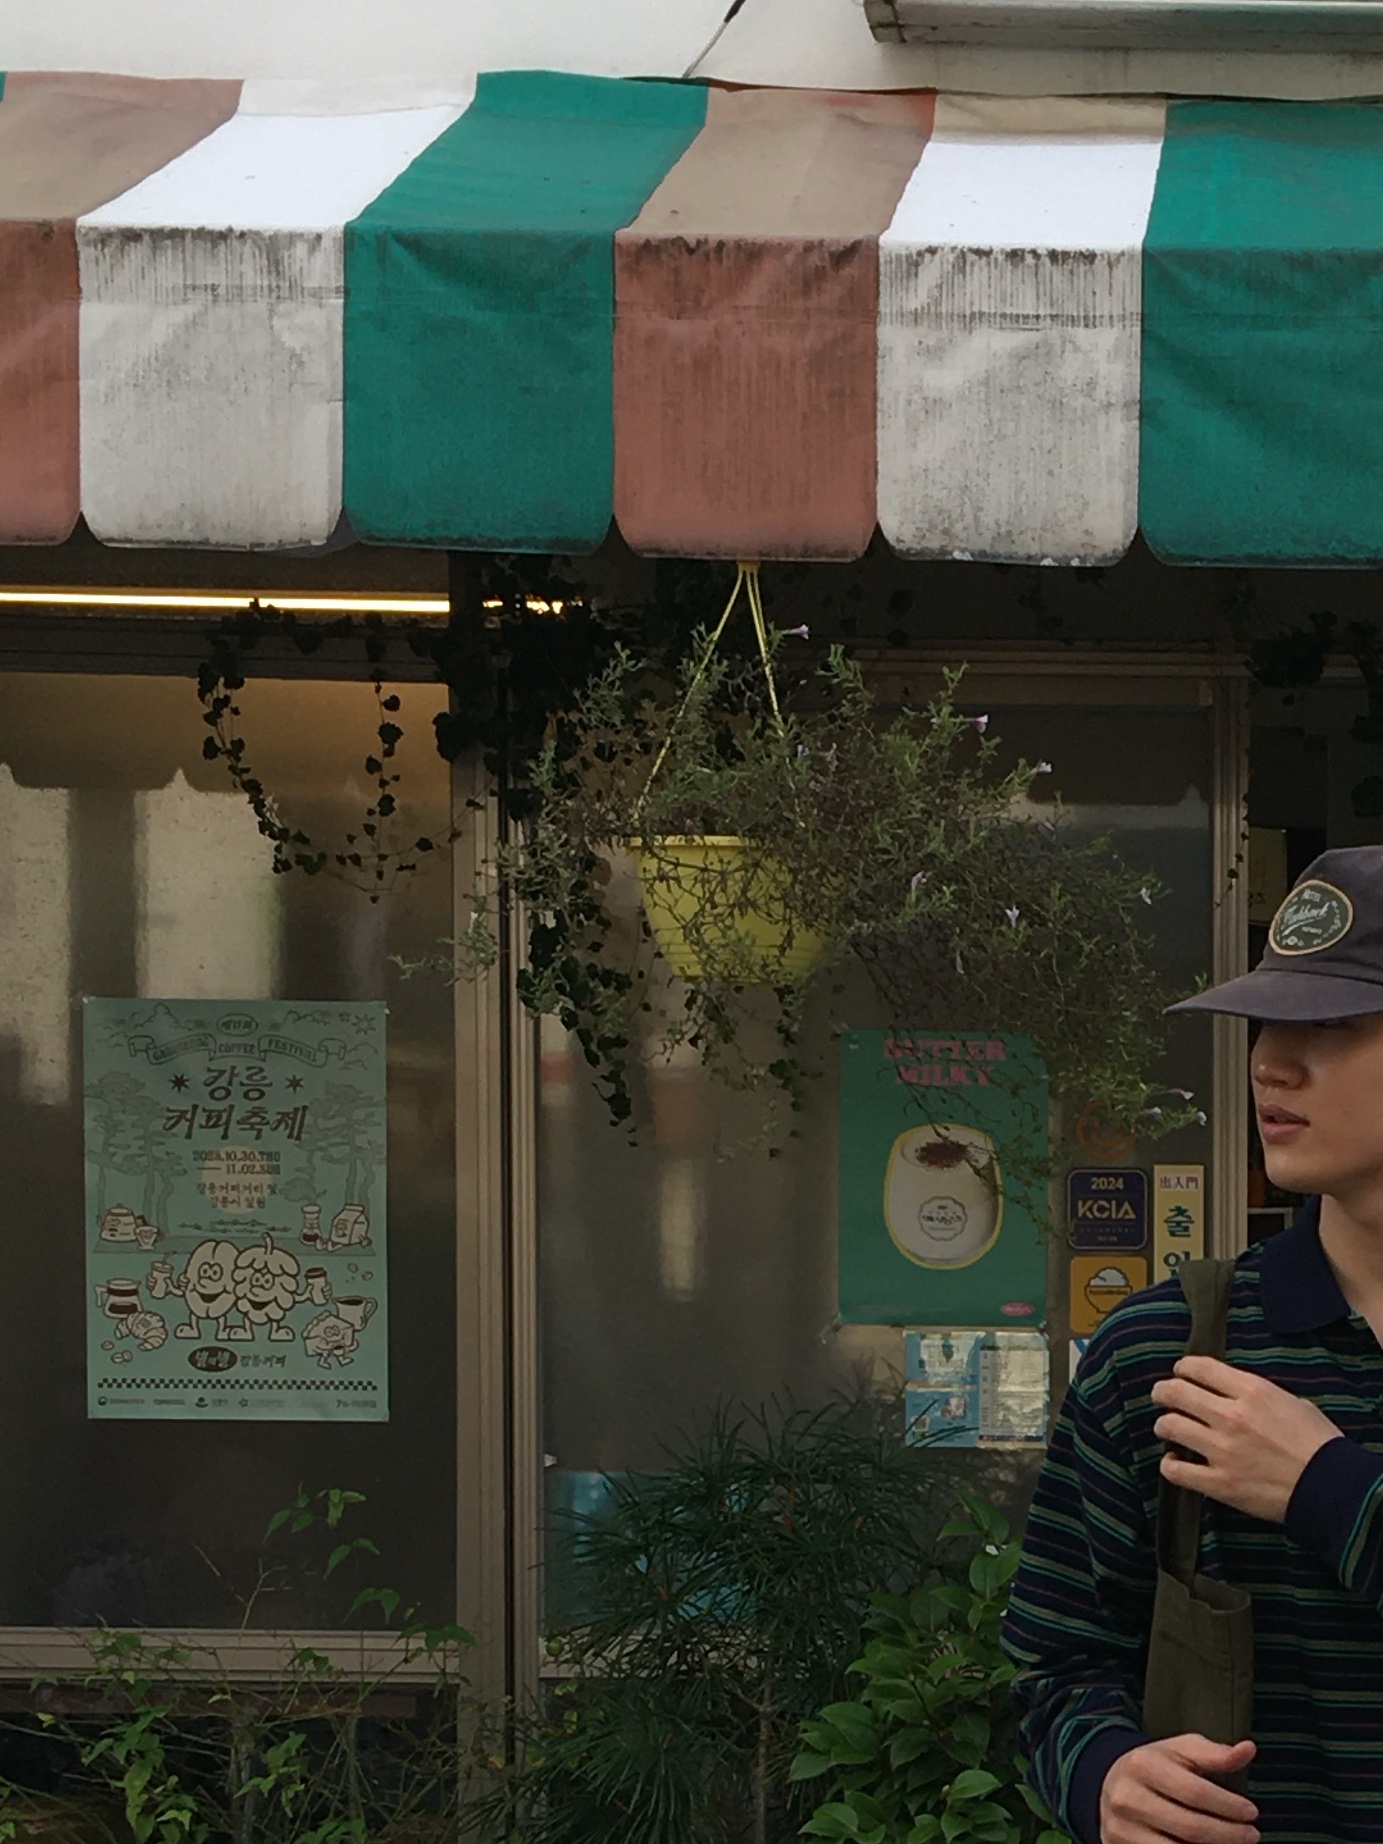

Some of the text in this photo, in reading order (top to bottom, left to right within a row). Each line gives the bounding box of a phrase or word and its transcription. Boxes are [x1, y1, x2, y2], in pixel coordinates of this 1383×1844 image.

[218, 1043, 256, 1055] COFFEE
[268, 1038, 317, 1062] FESTIVAL
[203, 1065, 273, 1101] 강릉
[896, 1064, 994, 1086] MILKY
[162, 1103, 309, 1141] 커피축제
[1090, 1176, 1125, 1191] 2024
[1160, 1176, 1199, 1190] 出入門
[1077, 1199, 1137, 1219] KCIA
